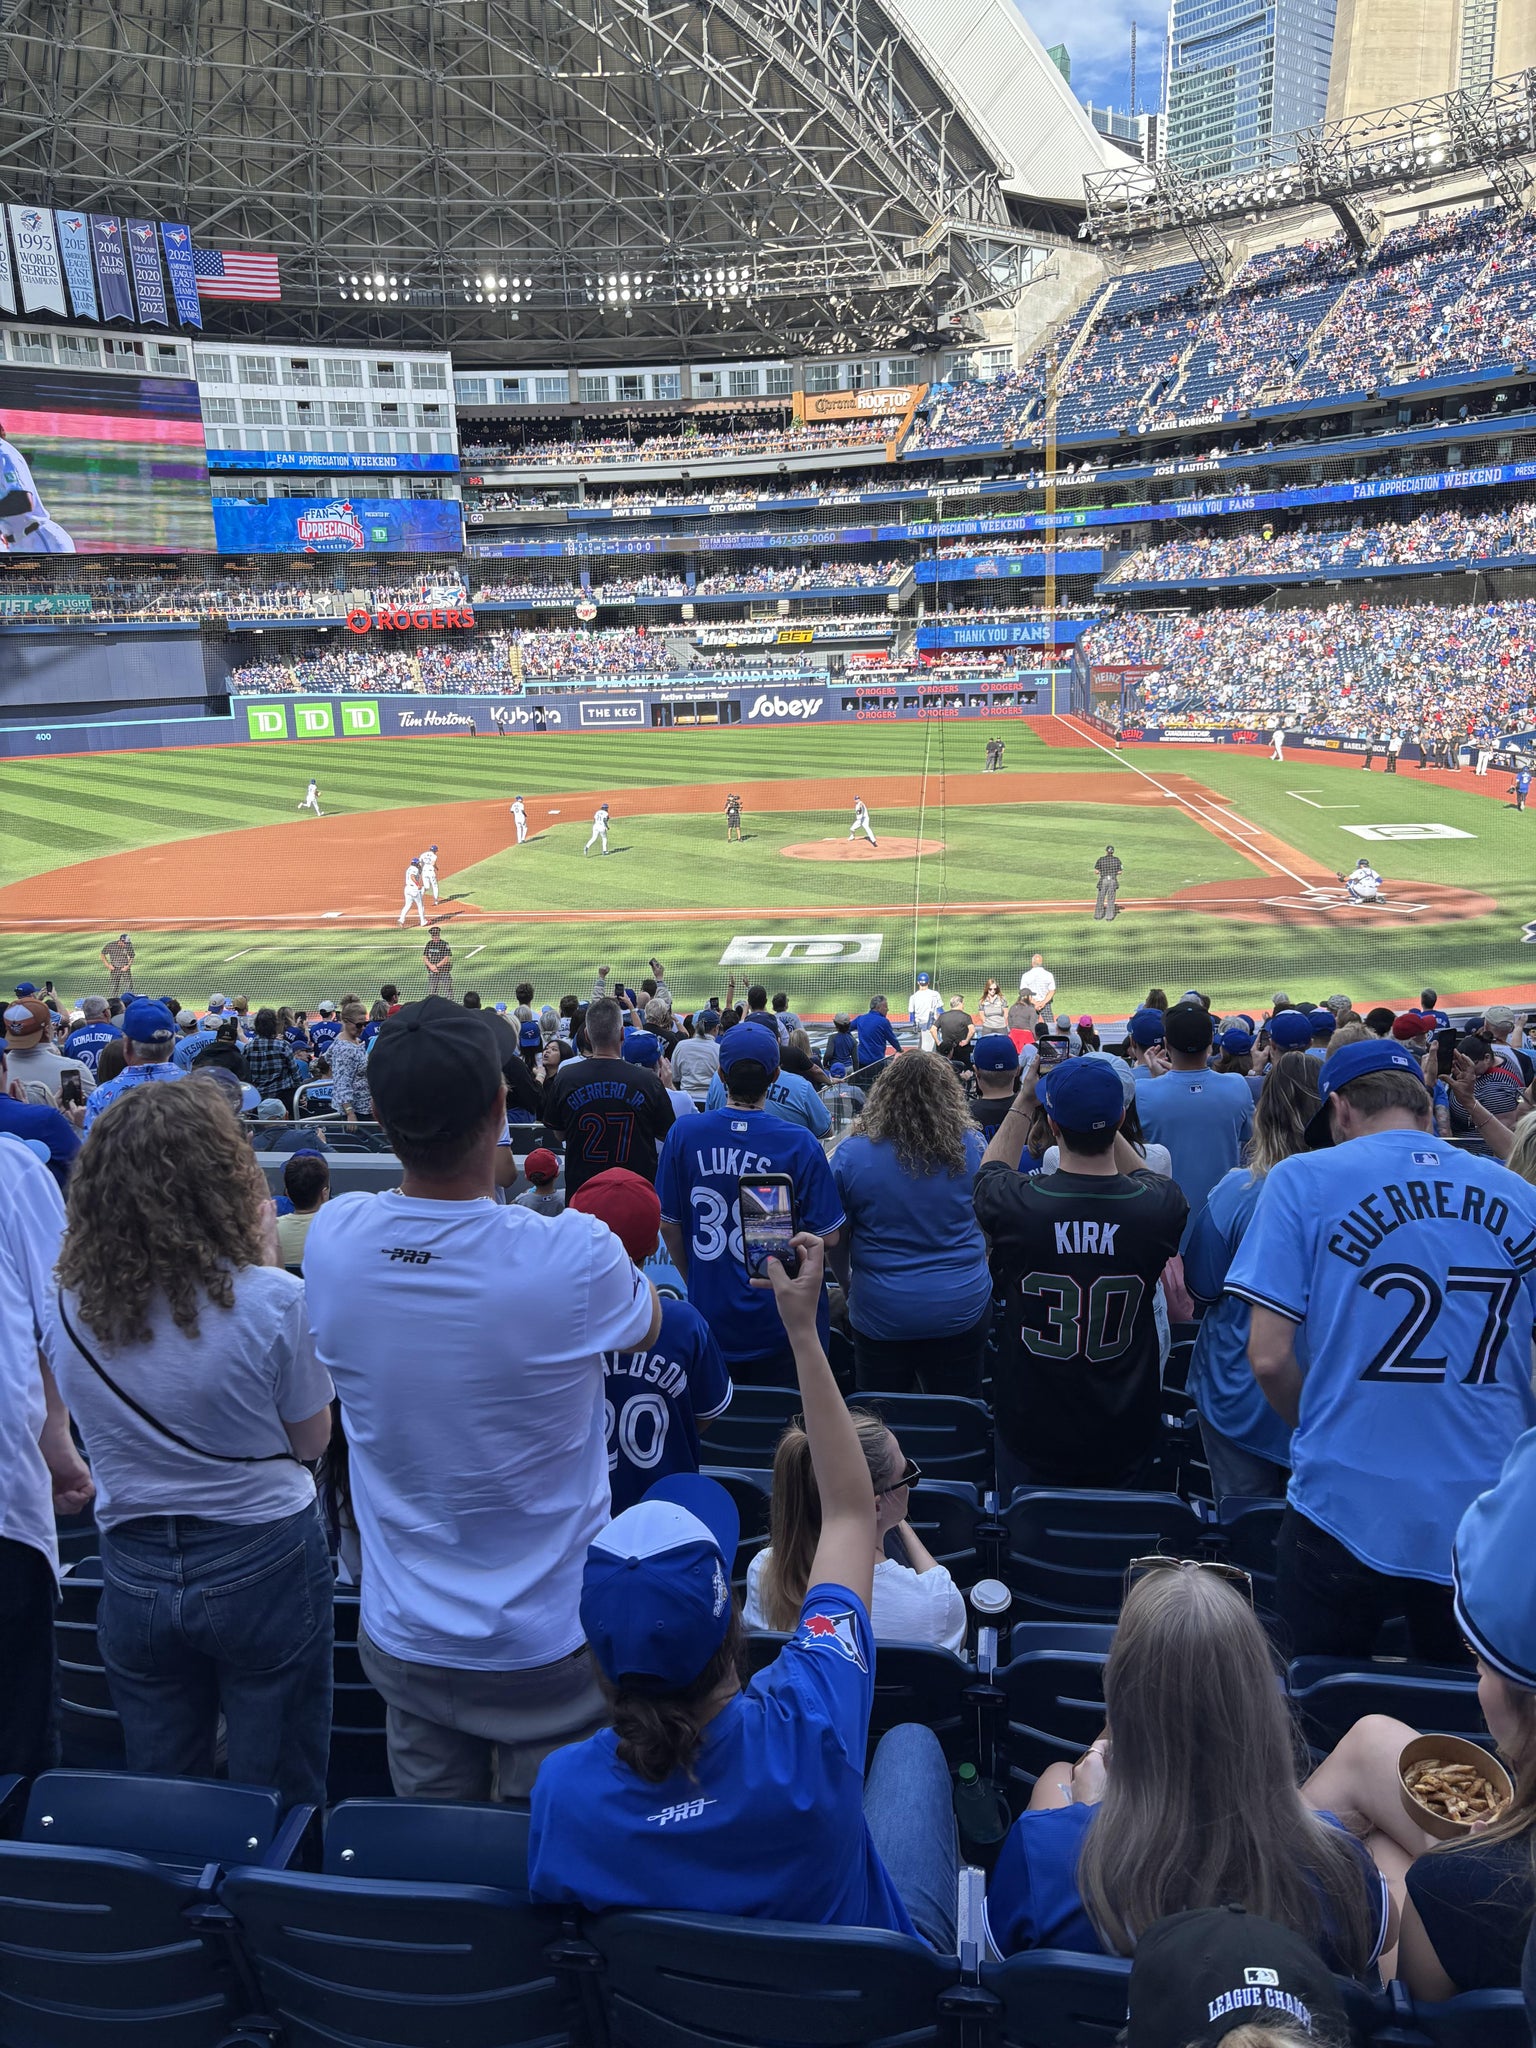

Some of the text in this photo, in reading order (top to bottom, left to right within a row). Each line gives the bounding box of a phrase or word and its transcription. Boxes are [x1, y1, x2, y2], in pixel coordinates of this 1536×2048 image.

[17, 233, 53, 251] 1993
[64, 238, 86, 250] 2015
[98, 241, 121, 254] 2016
[19, 252, 56, 266] WORLD
[135, 253, 157, 265] 2016
[168, 249, 191, 261] 2025
[66, 259, 90, 269] LEAGUE
[100, 256, 124, 268] ALDS
[20, 264, 58, 278] SERIES
[67, 267, 90, 279] EAST
[100, 266, 126, 276] CHAMPS
[136, 269, 160, 281] 2020
[171, 270, 194, 278] LEAGUE
[22, 275, 59, 286] CHAMPIONS
[173, 278, 194, 288] EAST
[138, 285, 163, 297] 2022
[140, 301, 165, 313] 2023
[178, 300, 198, 311] ALCS
[816, 393, 911, 414] Corona ROOFTOP
[872, 407, 896, 415] PATIO
[1150, 414, 1223, 432] JACKIE ROBINSON
[277, 453, 397, 467] FAN APPRECIATION WEEKEND
[1153, 461, 1220, 476] JOSÉ BAUTISTA
[1039, 474, 1097, 488] ROY HALLADAY
[1353, 484, 1376, 498] FAN
[1378, 476, 1440, 495] APPRECIATION
[1443, 469, 1502, 487] WEEKEND
[927, 486, 980, 497] PAUL BEESTON
[819, 495, 861, 506] PAT GILLICK
[1176, 498, 1255, 516] THANK YOU FANS
[310, 509, 329, 519] FAN
[612, 507, 651, 517] DAVE STIEB
[709, 502, 756, 513] CITO GASTON
[301, 521, 361, 543] APPRECIATION
[908, 525, 925, 536] FAN
[928, 522, 977, 535] APPRECIATION
[980, 518, 1026, 532] WEEKEND
[1076, 515, 1086, 523] TD
[373, 529, 386, 540] TD
[722, 536, 739, 544] ASSIST
[769, 532, 836, 546] 647-559-0060
[57, 599, 91, 608] FLIGHT
[378, 608, 475, 630] ROGERS
[702, 630, 774, 646] theScore
[779, 631, 812, 642] BET
[862, 629, 886, 637] CASINO
[954, 626, 1051, 643] THANK YOU FANS
[1034, 677, 1048, 685] 328
[1094, 672, 1121, 685] HEINZ
[865, 687, 897, 695] ROGERS
[927, 685, 959, 694] ROGERS
[990, 683, 1023, 691] ROGERS
[588, 707, 637, 718] THE KEG
[748, 694, 823, 719] Sobeys
[927, 709, 959, 717] ROGERS
[989, 706, 1023, 716] ROGERS
[298, 709, 329, 730] TD
[345, 707, 375, 728] TD
[398, 711, 471, 727] Tim Hortons
[490, 706, 562, 725] Kubota
[865, 711, 897, 719] ROGERS
[252, 712, 282, 732] TD
[36, 733, 51, 741] 400
[1121, 729, 1145, 740] HEINZ
[1232, 730, 1259, 742] HEINZ
[1343, 742, 1367, 751] BASELI
[1372, 745, 1386, 753] BOX
[748, 941, 861, 957] TD
[73, 1032, 112, 1046] DONALDSON
[182, 1039, 217, 1056] YESAVAG
[566, 1081, 627, 1111] GUERRERO
[578, 1112, 635, 1163] 27
[696, 1147, 771, 1177] LUKES
[1328, 1181, 1508, 1267] GUERRERO
[1054, 1221, 1120, 1256] KIRK
[1021, 1271, 1145, 1362] 30
[1359, 1262, 1522, 1385] 27
[651, 1798, 713, 1826] PRO
[1208, 1987, 1262, 2022] LEAGUE
